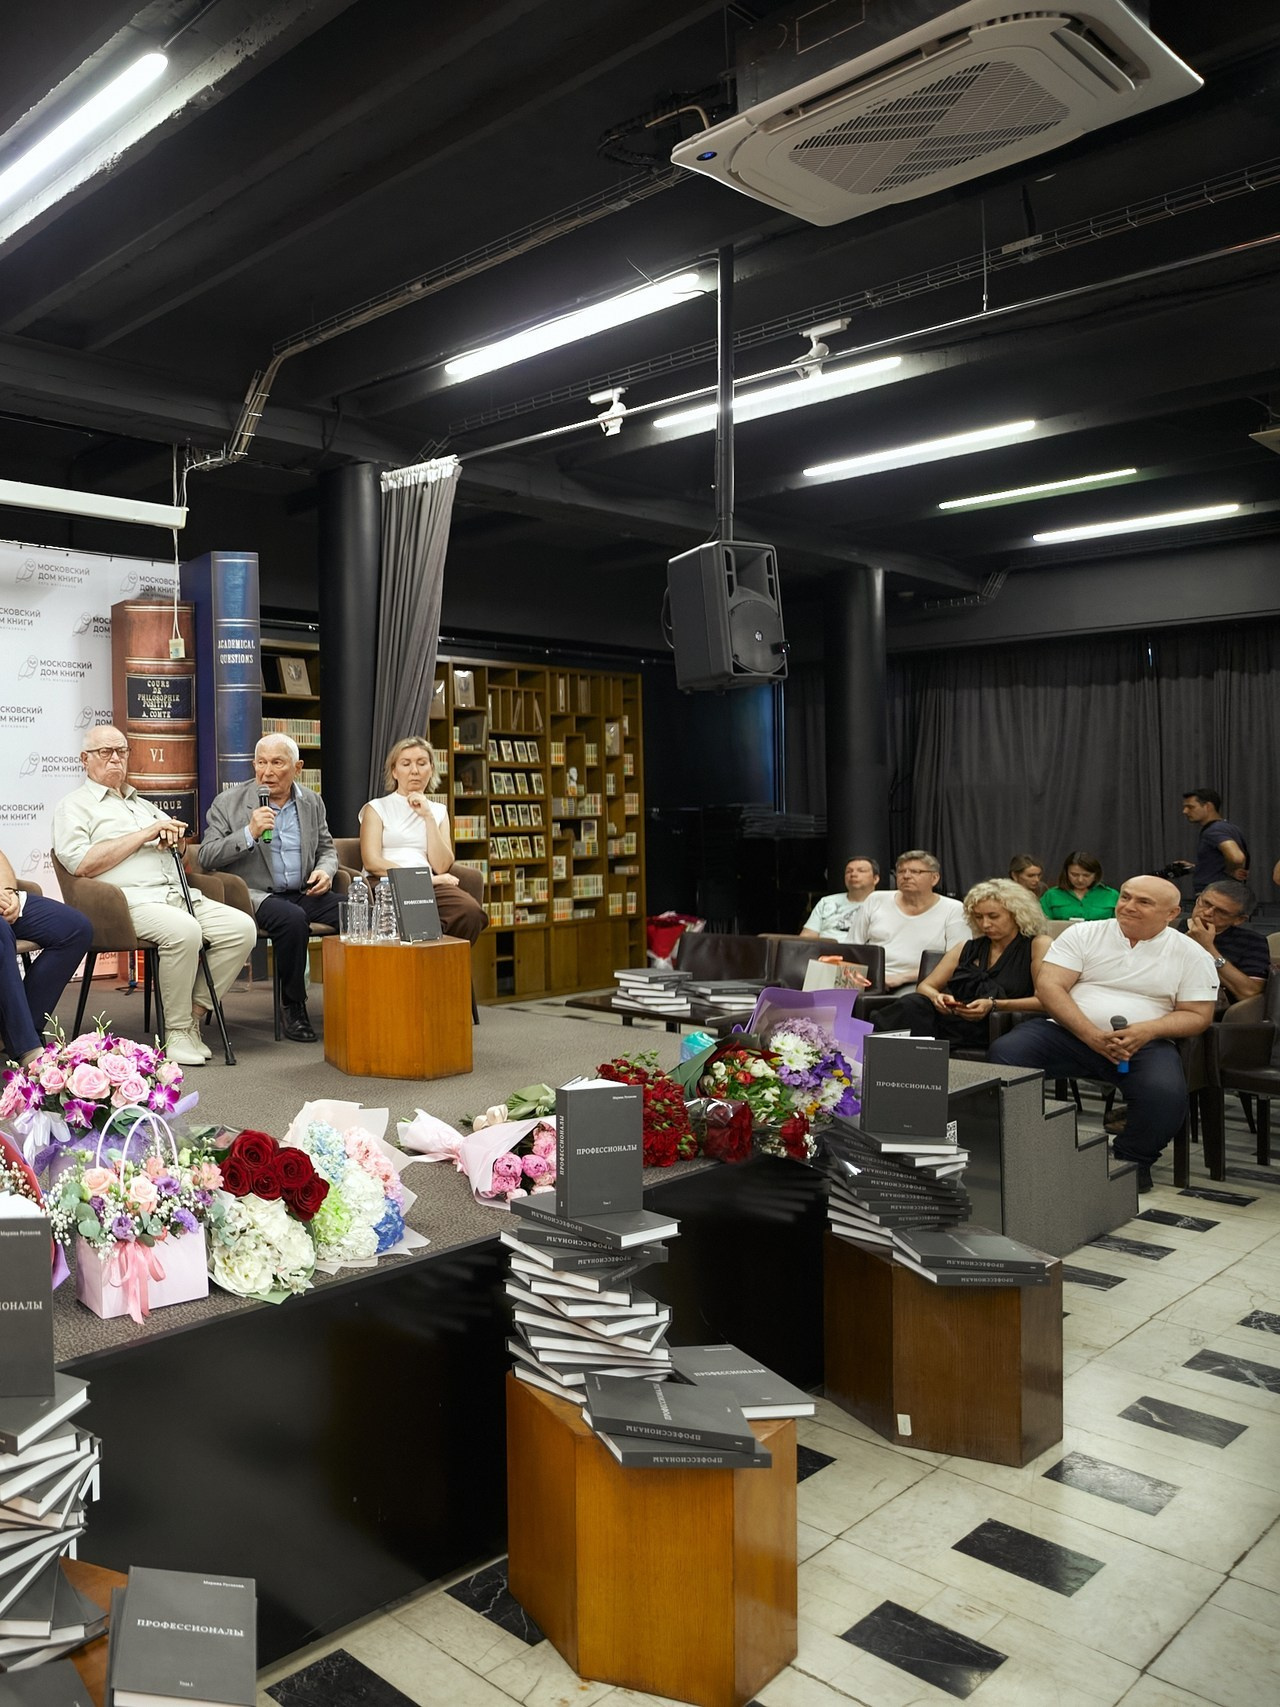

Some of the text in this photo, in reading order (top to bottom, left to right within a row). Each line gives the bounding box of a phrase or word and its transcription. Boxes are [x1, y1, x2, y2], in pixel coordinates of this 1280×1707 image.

[38, 562, 90, 576] МОСКОВСКИЙ
[38, 572, 83, 584] ДОМ КНИГИ
[7, 616, 34, 626] КНИГИ
[40, 659, 92, 670] МОСКОВСКИЙ
[220, 654, 254, 665] QUESTIONS
[40, 668, 86, 678] ДОМ КНИГИ
[147, 680, 170, 688] COURS
[137, 693, 180, 702] PHILOSOPHIE
[9, 714, 36, 724] КНИГИ
[149, 710, 171, 718] COMTE
[150, 748, 165, 762] VI
[42, 764, 60, 772] ДОМ
[155, 800, 182, 810] SIQUE
[10, 812, 37, 822] КНИГИ
[876, 1080, 942, 1091] ПРОФЕССИОНАЛЫ
[576, 1144, 638, 1156] ПРОФЕССИОНАЛЫ
[870, 1180, 927, 1190] ПРОФЕССИОНАЛЫ
[531, 1210, 583, 1232] ПРОФЕССИОНАЛЫ
[546, 1236, 613, 1250] ПРОФЕССИОНАЛЫ
[578, 1256, 632, 1266] ПРОФЕССИОНАЛЫ
[946, 1260, 1004, 1268] ПРОФЕССИОНАЛЫ
[694, 1368, 766, 1377] ПРОФЕССИОНАЛЫ
[626, 1424, 702, 1441] ПРОФЕССИОНАЛЫ
[652, 1456, 723, 1464] ПРОФЕССИОНАЛЫ
[136, 1618, 244, 1637] ПРОФЕССИОНАЛЫ
